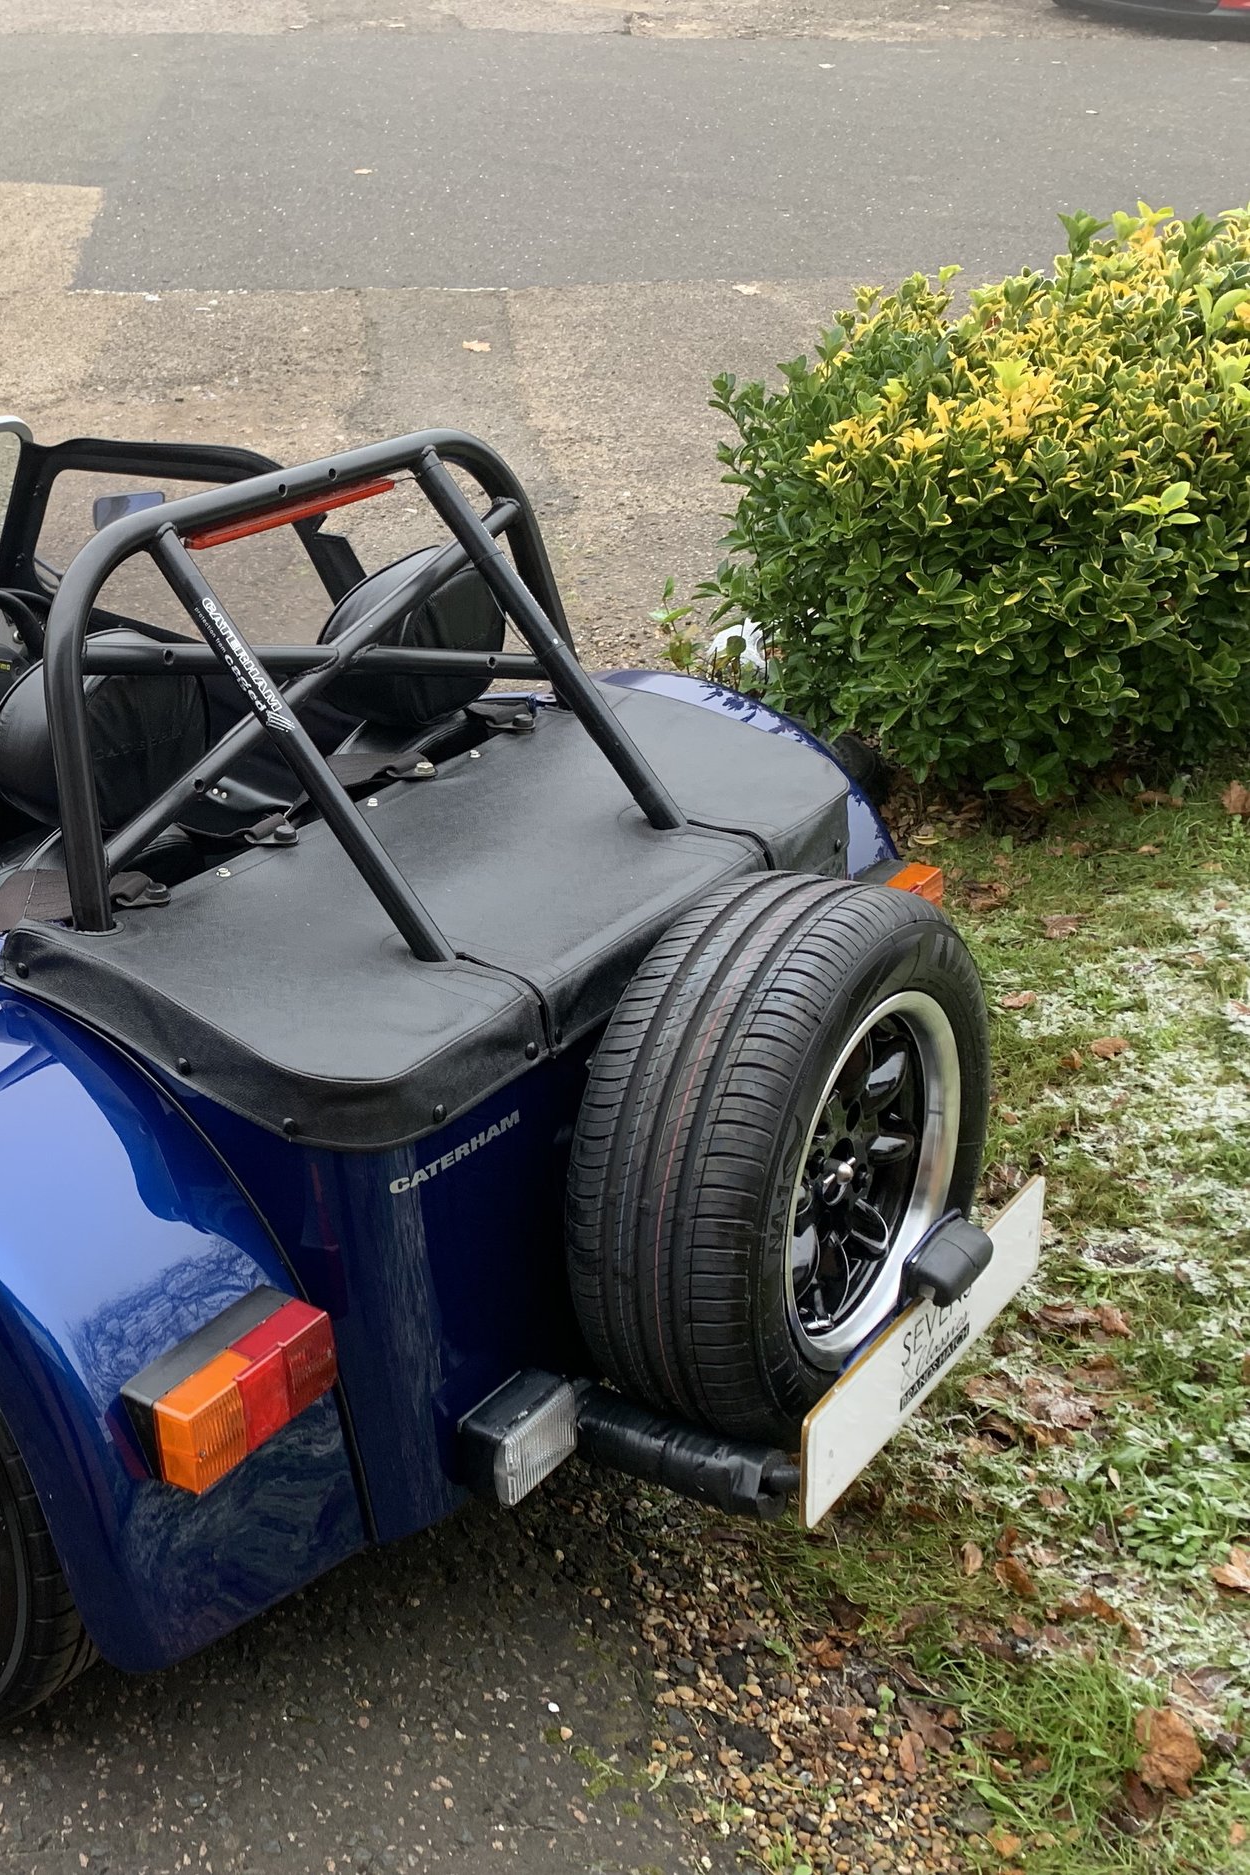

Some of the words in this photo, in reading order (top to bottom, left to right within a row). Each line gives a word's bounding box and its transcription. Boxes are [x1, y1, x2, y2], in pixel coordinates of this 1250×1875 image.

[194, 607, 216, 639] protection
[224, 654, 267, 712] caged
[202, 597, 282, 712] CATERHAM
[389, 1109, 520, 1194] CATERHAM
